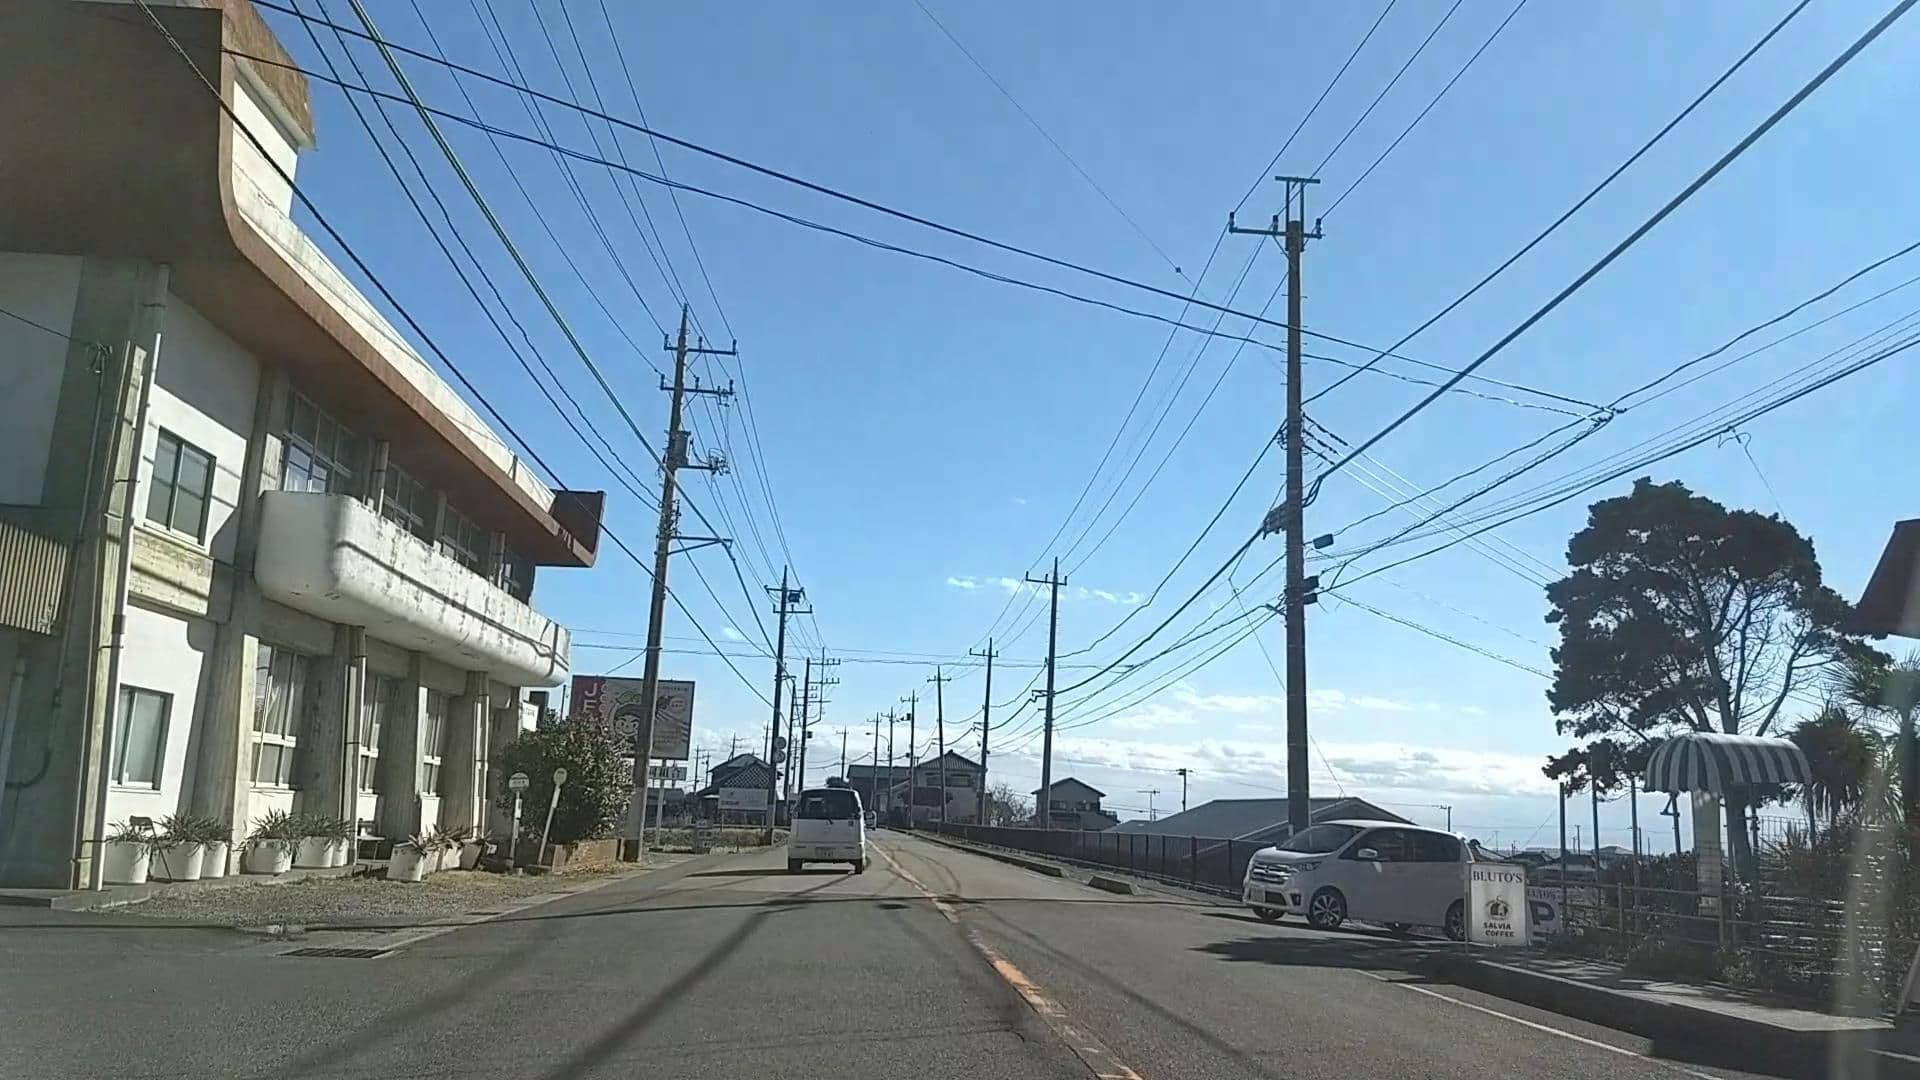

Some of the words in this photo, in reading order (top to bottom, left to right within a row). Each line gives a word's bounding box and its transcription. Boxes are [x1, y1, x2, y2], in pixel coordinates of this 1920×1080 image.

[1473, 871, 1523, 883] BLUTO'S
[1528, 900, 1555, 926] P
[1484, 922, 1512, 930] SALVIA
